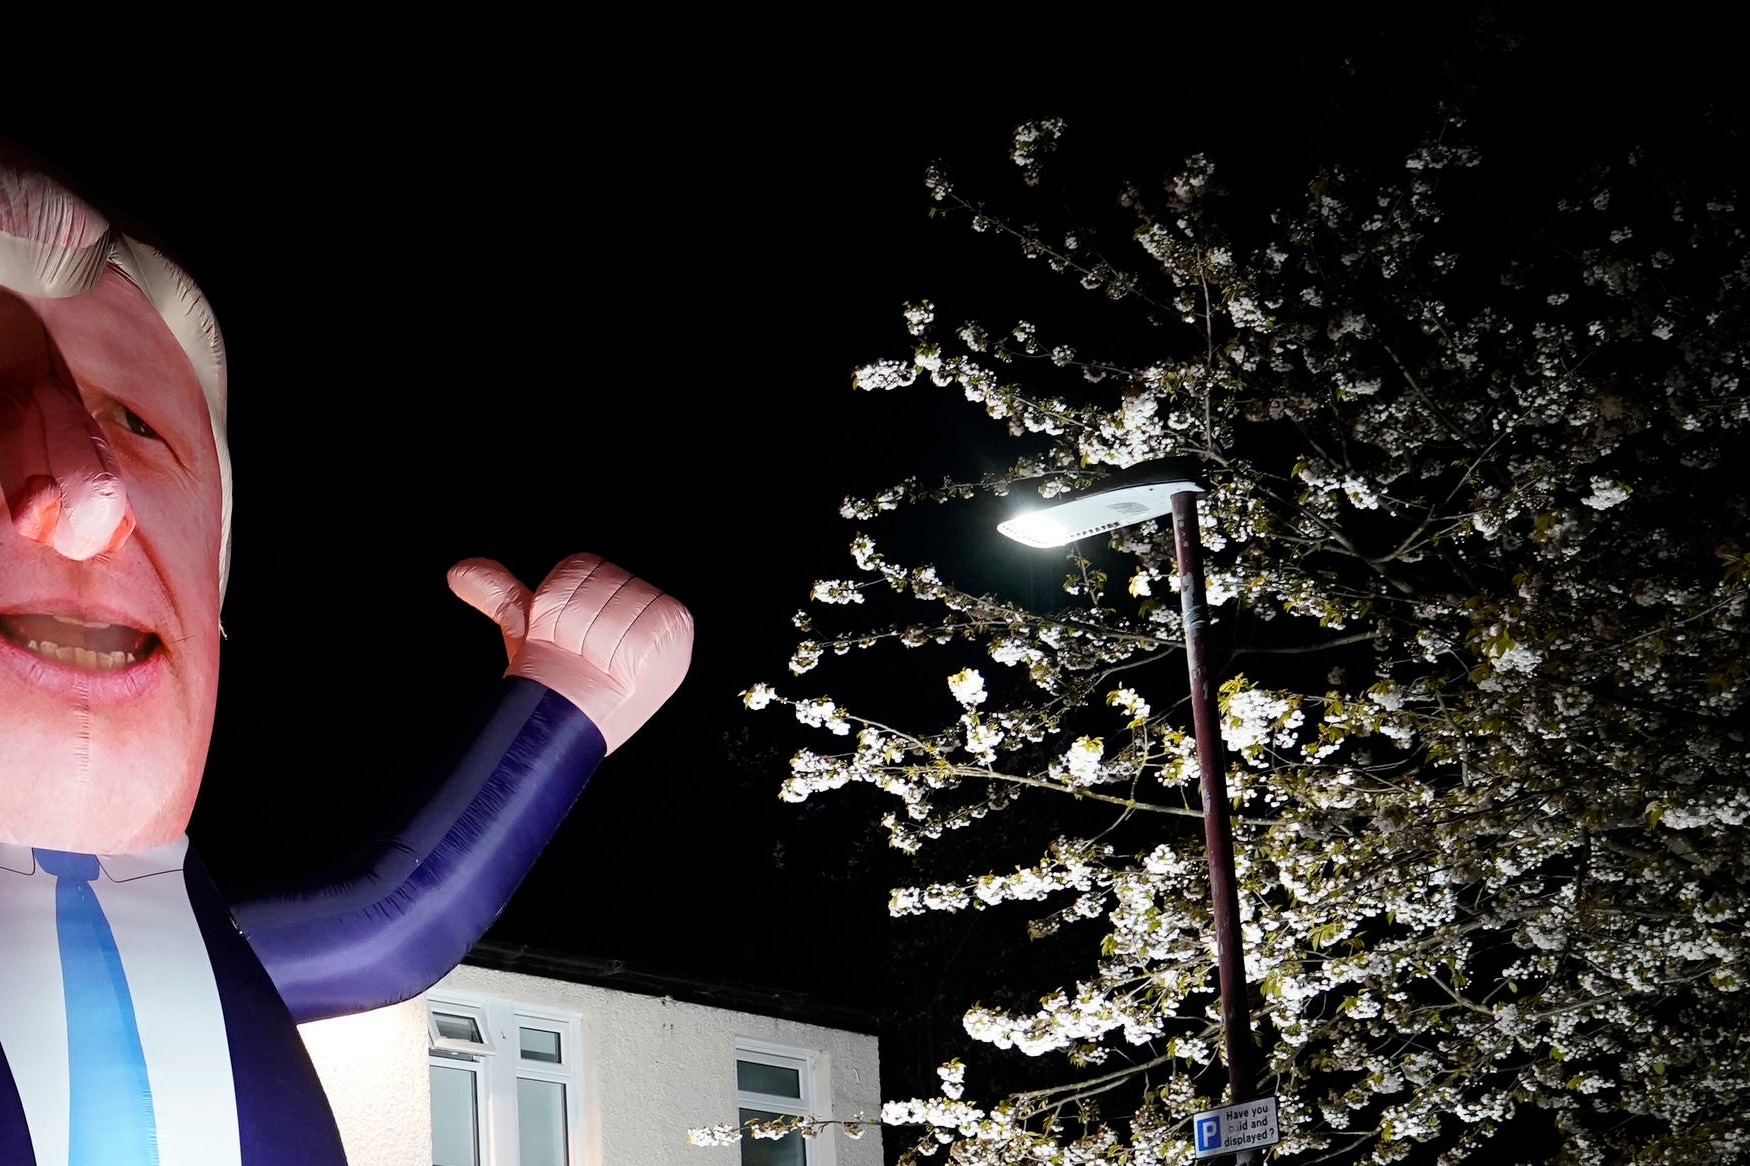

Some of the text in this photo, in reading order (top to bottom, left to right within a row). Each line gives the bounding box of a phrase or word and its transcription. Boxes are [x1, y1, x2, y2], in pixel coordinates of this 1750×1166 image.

[1226, 1106, 1268, 1121] Have you
[1228, 1116, 1268, 1133] id and
[1202, 1120, 1217, 1147] P
